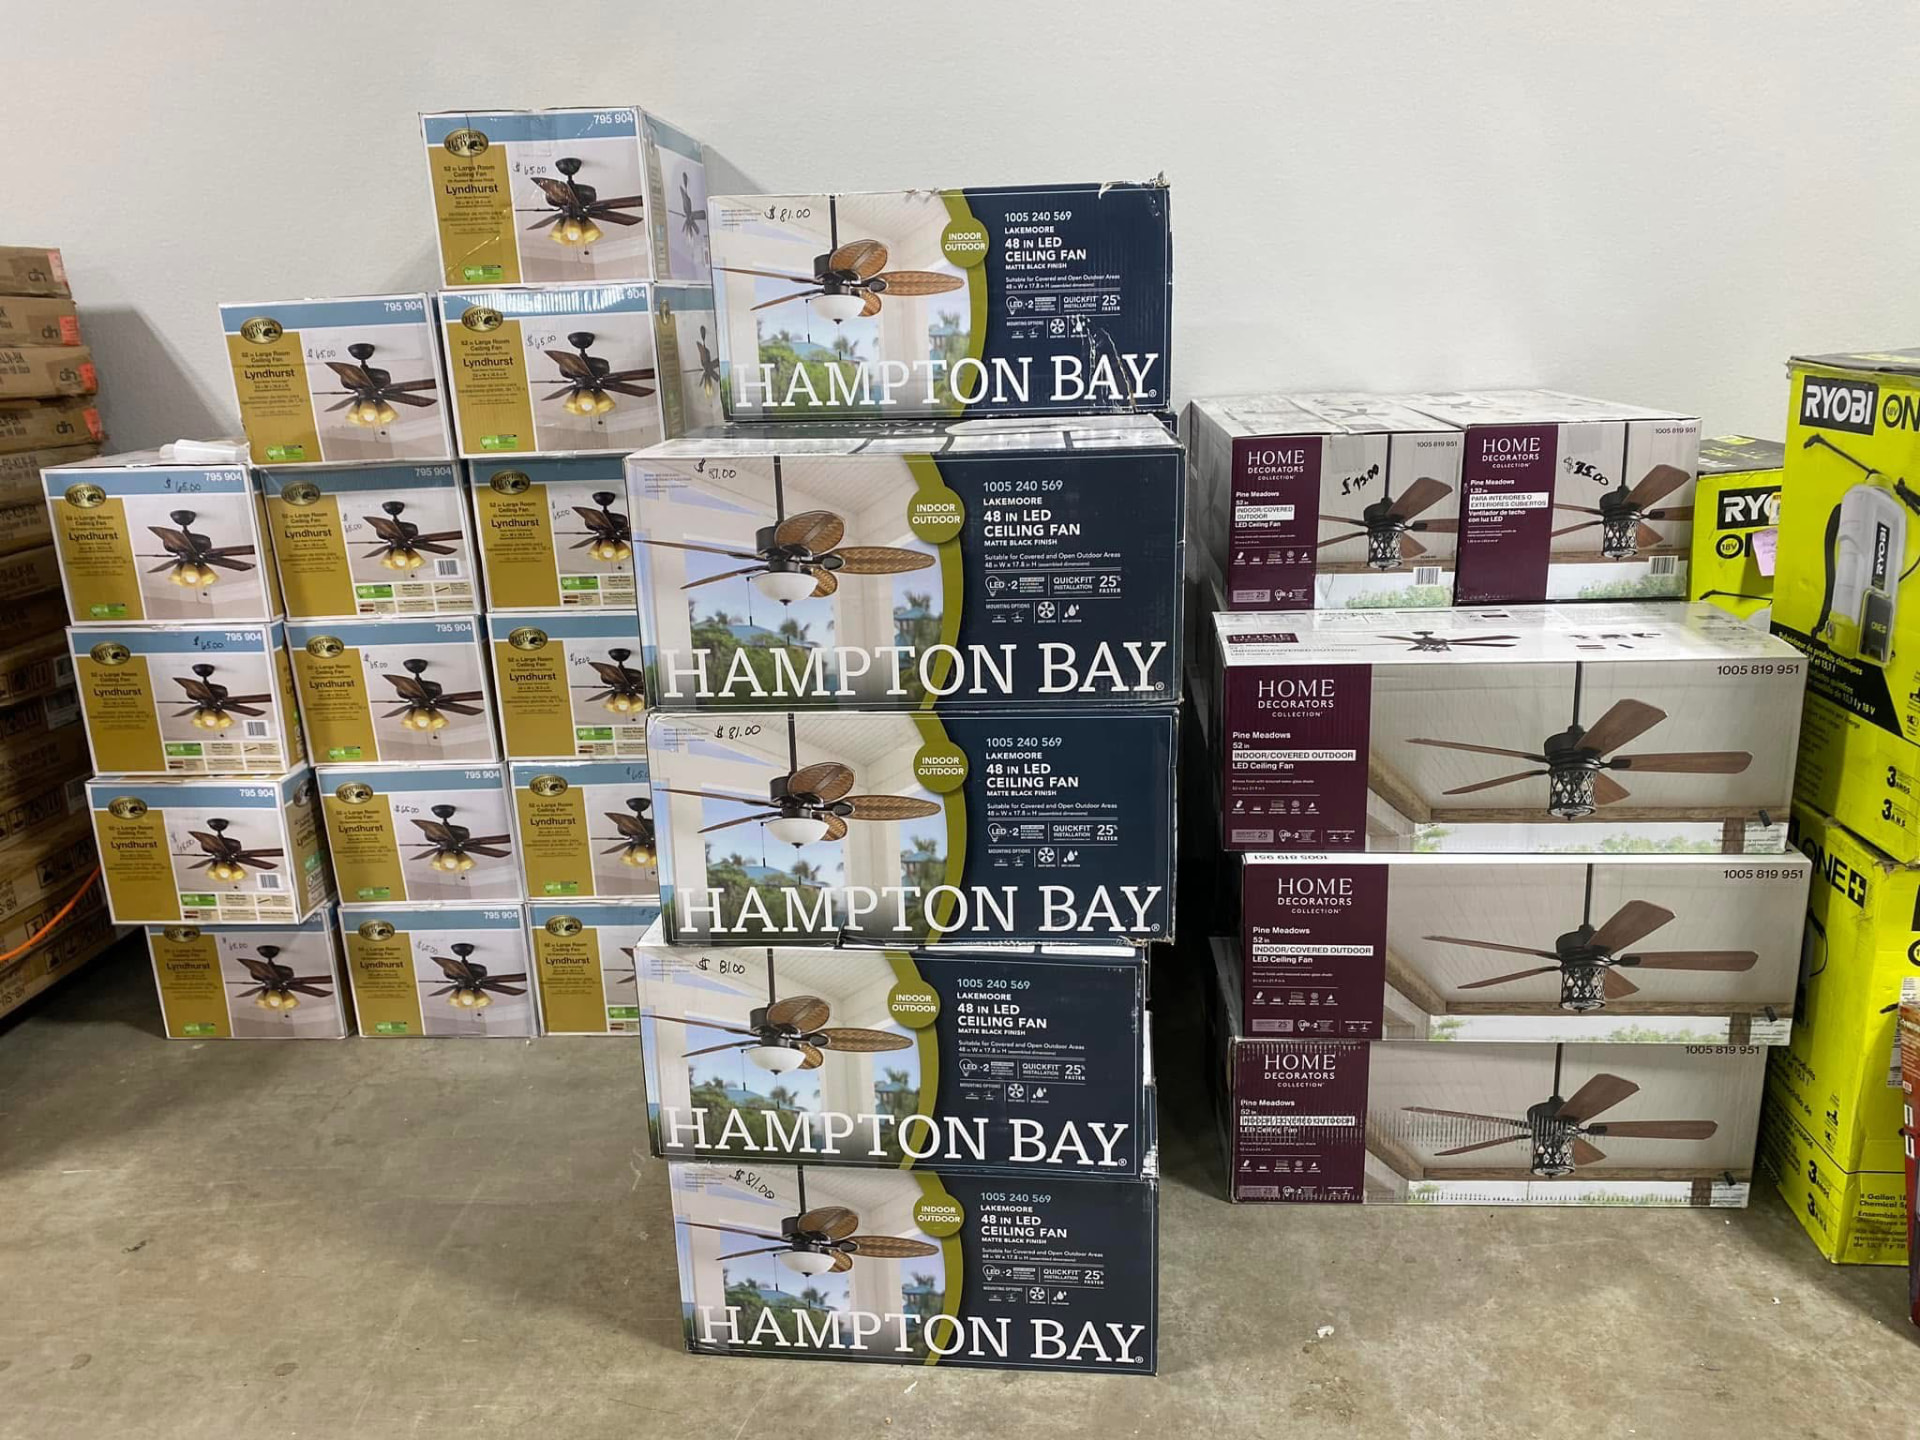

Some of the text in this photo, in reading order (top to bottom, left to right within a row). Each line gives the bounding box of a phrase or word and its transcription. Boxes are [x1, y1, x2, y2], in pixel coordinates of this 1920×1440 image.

[594, 114, 633, 124] 795 904
[446, 184, 498, 195] Lyndhurst
[1005, 211, 1072, 223] 1005 240 569
[1005, 226, 1054, 234] LAKEMOORE
[948, 231, 982, 241] INDOOR
[945, 242, 986, 252] OUTDOOR
[1005, 237, 1062, 249] 48 IN LED
[1006, 249, 1086, 262] CEILING FAN
[384, 302, 423, 311] 795 904
[463, 357, 513, 368] Lyndhurst
[245, 369, 294, 380] Lyndhurst
[735, 356, 1033, 408] HAMPTON
[1805, 385, 1874, 425] RYOBI
[1483, 438, 1541, 452] HOME
[1248, 450, 1305, 465] HOME
[1482, 453, 1539, 462] DECORATORS
[415, 467, 451, 477] 795 904
[1248, 465, 1304, 474] DECORATORS
[204, 473, 222, 481] 795
[983, 480, 1063, 493] 1005 240 569
[983, 497, 1042, 506] LAKEMOORE
[917, 503, 955, 512] INDOOR
[912, 515, 960, 525] OUTDOOR
[984, 510, 1051, 522] 48 IN LED
[491, 518, 539, 528] Lyndhurst
[285, 529, 332, 539] Lyndhurst
[984, 524, 1080, 537] CEILING FAN
[69, 532, 118, 542] Lyndhurst
[1876, 527, 1888, 575] RYOBI
[225, 633, 261, 641] 795 904
[664, 644, 1017, 699] HAMPTON
[1717, 664, 1799, 675] 1005 819 951
[510, 672, 556, 682] Lyndhurst
[309, 680, 354, 689] Lyndhurst
[1259, 679, 1335, 697] HOME
[94, 688, 142, 697] Lyndhurst
[1258, 700, 1334, 708] DECORATORS
[986, 737, 1062, 747] 1005 240 569
[922, 757, 959, 765] INDOOR
[986, 752, 1042, 760] LAKEMOORE
[918, 767, 964, 775] OUTDOOR
[987, 764, 1051, 774] 48 IN LED
[1250, 762, 1277, 770] Ceiling
[987, 777, 1079, 788] CEILING FAN
[530, 817, 576, 827] Lyndhurst
[338, 824, 383, 833] Lyndhurst
[111, 840, 157, 850] Lyndhurst
[1724, 869, 1803, 879] 1005 819 951
[1278, 878, 1353, 895] HOME
[1278, 898, 1352, 906] DECORATORS
[677, 885, 1018, 933] HAMPTON
[360, 961, 403, 969] Lyndhurst
[546, 957, 590, 965] Lyndhurst
[957, 979, 1030, 989] 1005 240 569
[896, 994, 931, 1002] INDOOR
[957, 992, 1011, 1000] LAKEMOORE
[892, 1004, 936, 1013] OUTDOOR
[957, 1004, 1020, 1015] 48 IN LED
[958, 1016, 1047, 1029] CEILING FAN
[1265, 1054, 1335, 1070] HOME
[1265, 1072, 1335, 1080] DECORATORS
[663, 1106, 990, 1160] HAMPTON
[981, 1192, 1051, 1203] 1005 240 569
[922, 1206, 956, 1214] INDOOR
[981, 1205, 1033, 1213] LAKEMOORE
[918, 1215, 960, 1223] OUTDOOR
[981, 1215, 996, 1224] 48
[1016, 1216, 1041, 1225] LED
[981, 1226, 1067, 1238] CEILING FAN
[698, 1305, 1011, 1357] HAMPTON
